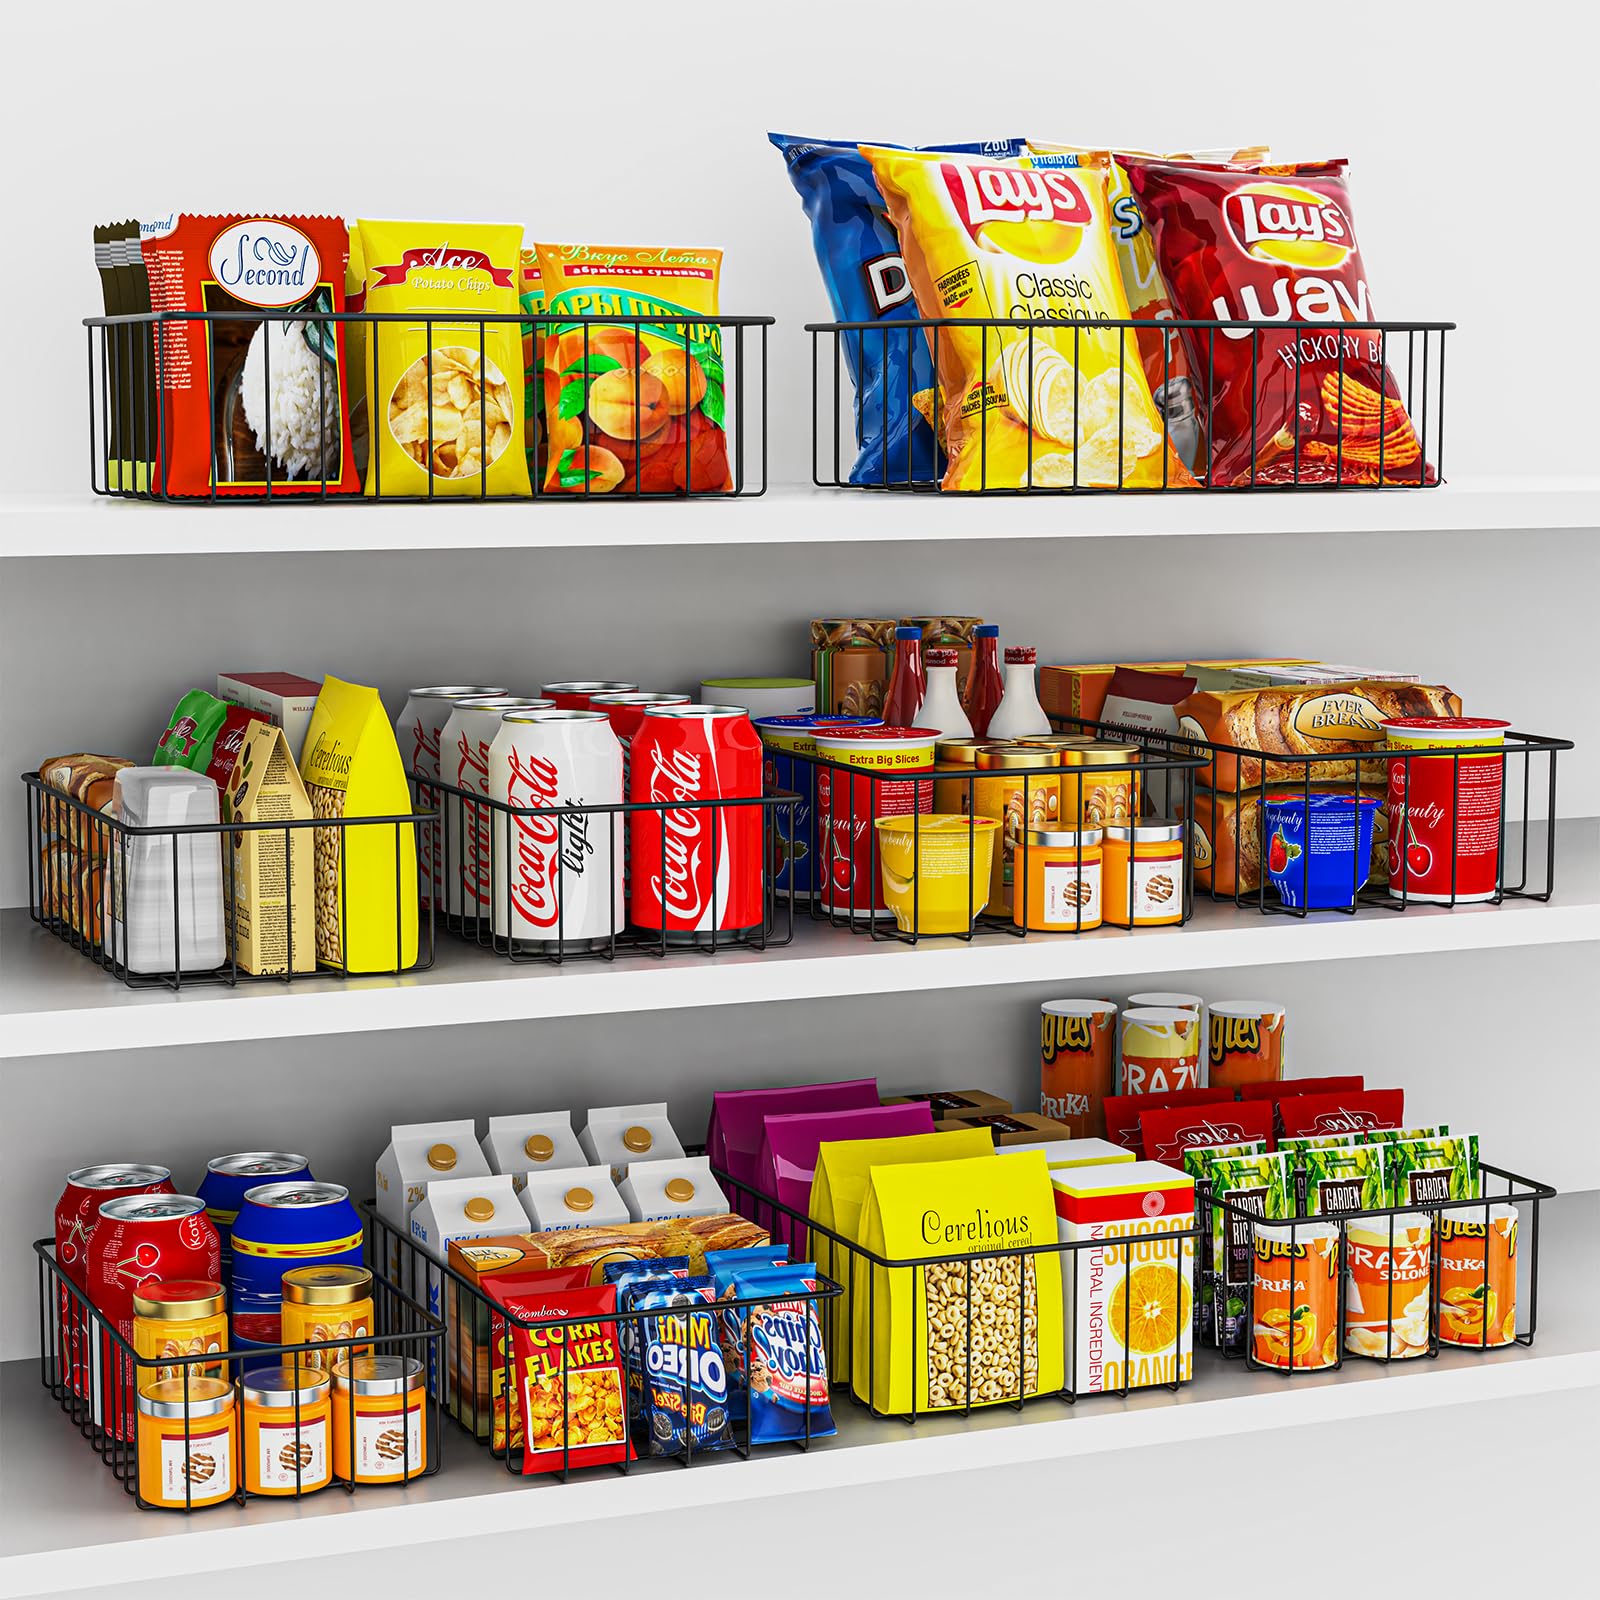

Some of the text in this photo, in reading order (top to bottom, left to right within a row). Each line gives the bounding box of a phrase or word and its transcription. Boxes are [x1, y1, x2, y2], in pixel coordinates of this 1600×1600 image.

[967, 162, 1092, 226] Lay's
[1238, 195, 1345, 242] Lay's
[220, 234, 309, 286] Second
[411, 240, 484, 271] Ace
[560, 244, 629, 267] Вкус
[573, 265, 643, 276] абрикосы
[411, 276, 491, 296] Potato Chips
[1015, 272, 1093, 300] Classic
[1277, 334, 1361, 371] HICKORY
[1322, 699, 1364, 715] EVER
[1312, 714, 1383, 732] BREAD
[849, 754, 874, 765] Extra
[876, 754, 893, 766] Big
[895, 753, 920, 764] Slices
[507, 744, 560, 928] Coca-Cola
[561, 796, 594, 878] light
[650, 738, 701, 920] Coca-Cola
[1325, 1186, 1361, 1211] GARDEN
[1415, 1176, 1449, 1202] GARDEN
[188, 1216, 202, 1247] Kott
[921, 1208, 1029, 1245] Cerelious
[1007, 1232, 1033, 1249] cereal
[528, 1322, 602, 1347] CORN
[1088, 1301, 1103, 1393] INGREDIENT
[525, 1338, 615, 1386] FLAKES
